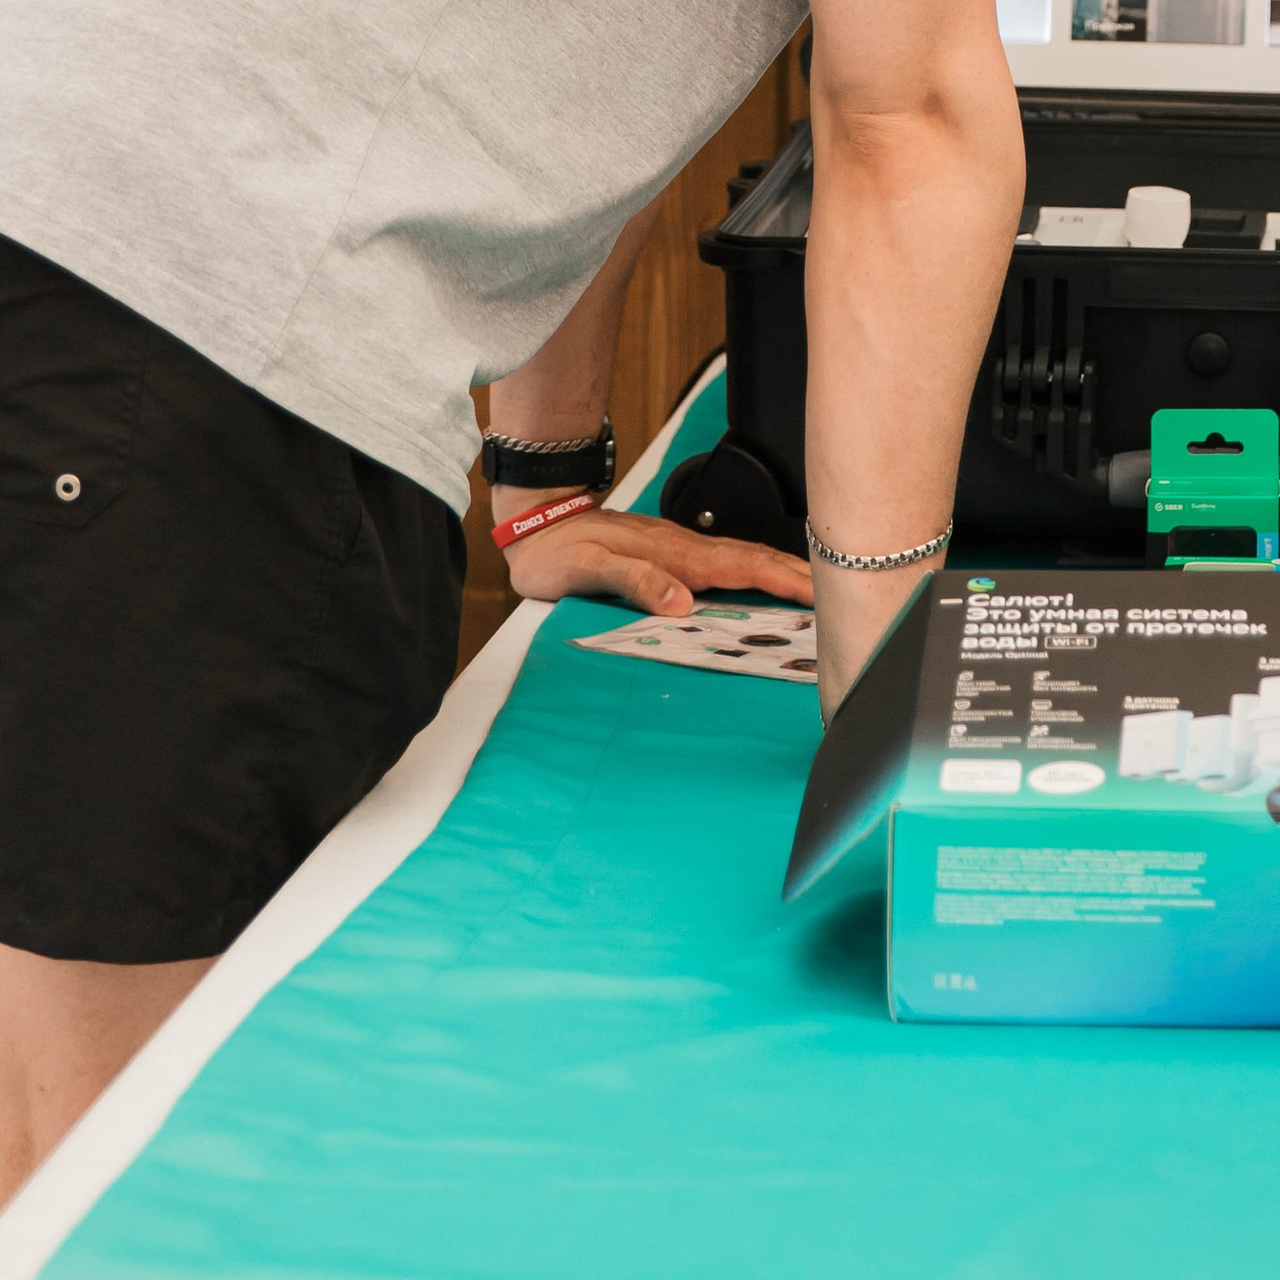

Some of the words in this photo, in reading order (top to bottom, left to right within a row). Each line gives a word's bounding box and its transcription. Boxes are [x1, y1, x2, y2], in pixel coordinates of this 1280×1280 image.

[967, 592, 1074, 607] Салют!
[966, 606, 1022, 621] Это
[1029, 608, 1120, 623] умная
[1126, 608, 1248, 622] система
[963, 622, 1078, 636] защиты
[1084, 622, 1120, 635] от
[1127, 621, 1268, 637] протечек
[961, 636, 1039, 650] воды
